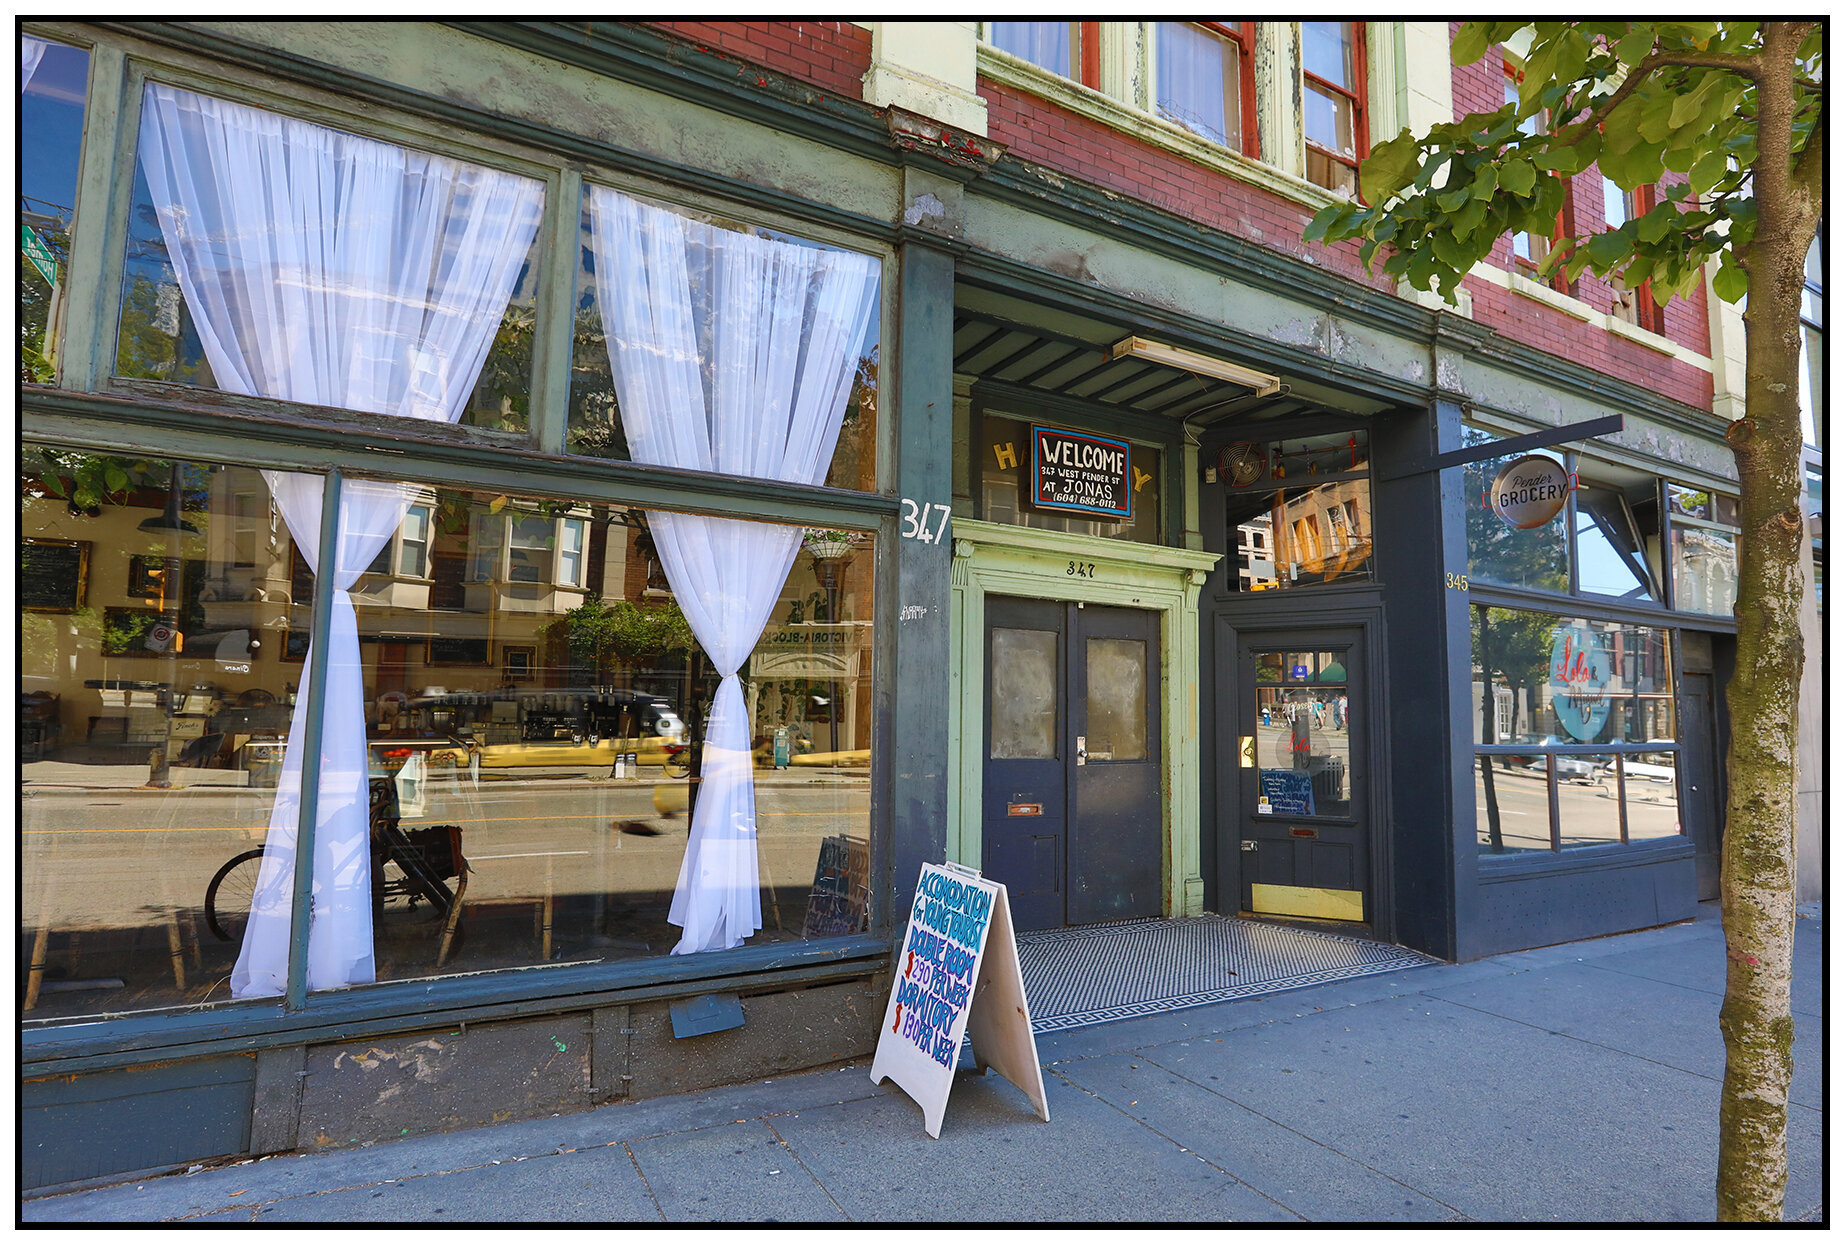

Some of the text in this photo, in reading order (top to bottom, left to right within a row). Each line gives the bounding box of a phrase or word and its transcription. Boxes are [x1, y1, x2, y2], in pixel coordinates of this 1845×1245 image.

[1041, 437, 1125, 475] WELCOME
[1041, 466, 1121, 485] 347 WEST PENDER ST
[1043, 478, 1113, 500] AT JONAS
[1053, 491, 1117, 509] (604) 688-0112
[1500, 483, 1567, 508] GROCERY
[1511, 473, 1553, 490] Pender
[901, 498, 951, 545] 347
[1066, 561, 1096, 578] 347
[1446, 572, 1469, 592] 345
[1555, 635, 1599, 683] Lola &
[917, 869, 992, 921] ACCOMODATION
[922, 897, 950, 936] YOUNG
[947, 909, 988, 954] TOURIST
[907, 925, 977, 986] DOUBLE ROOM
[896, 975, 959, 1037] DORMITORY
[929, 966, 948, 1001] PER
[945, 975, 972, 1012] WEEK
[915, 1019, 934, 1054] PER
[931, 1030, 957, 1072] WEEK
